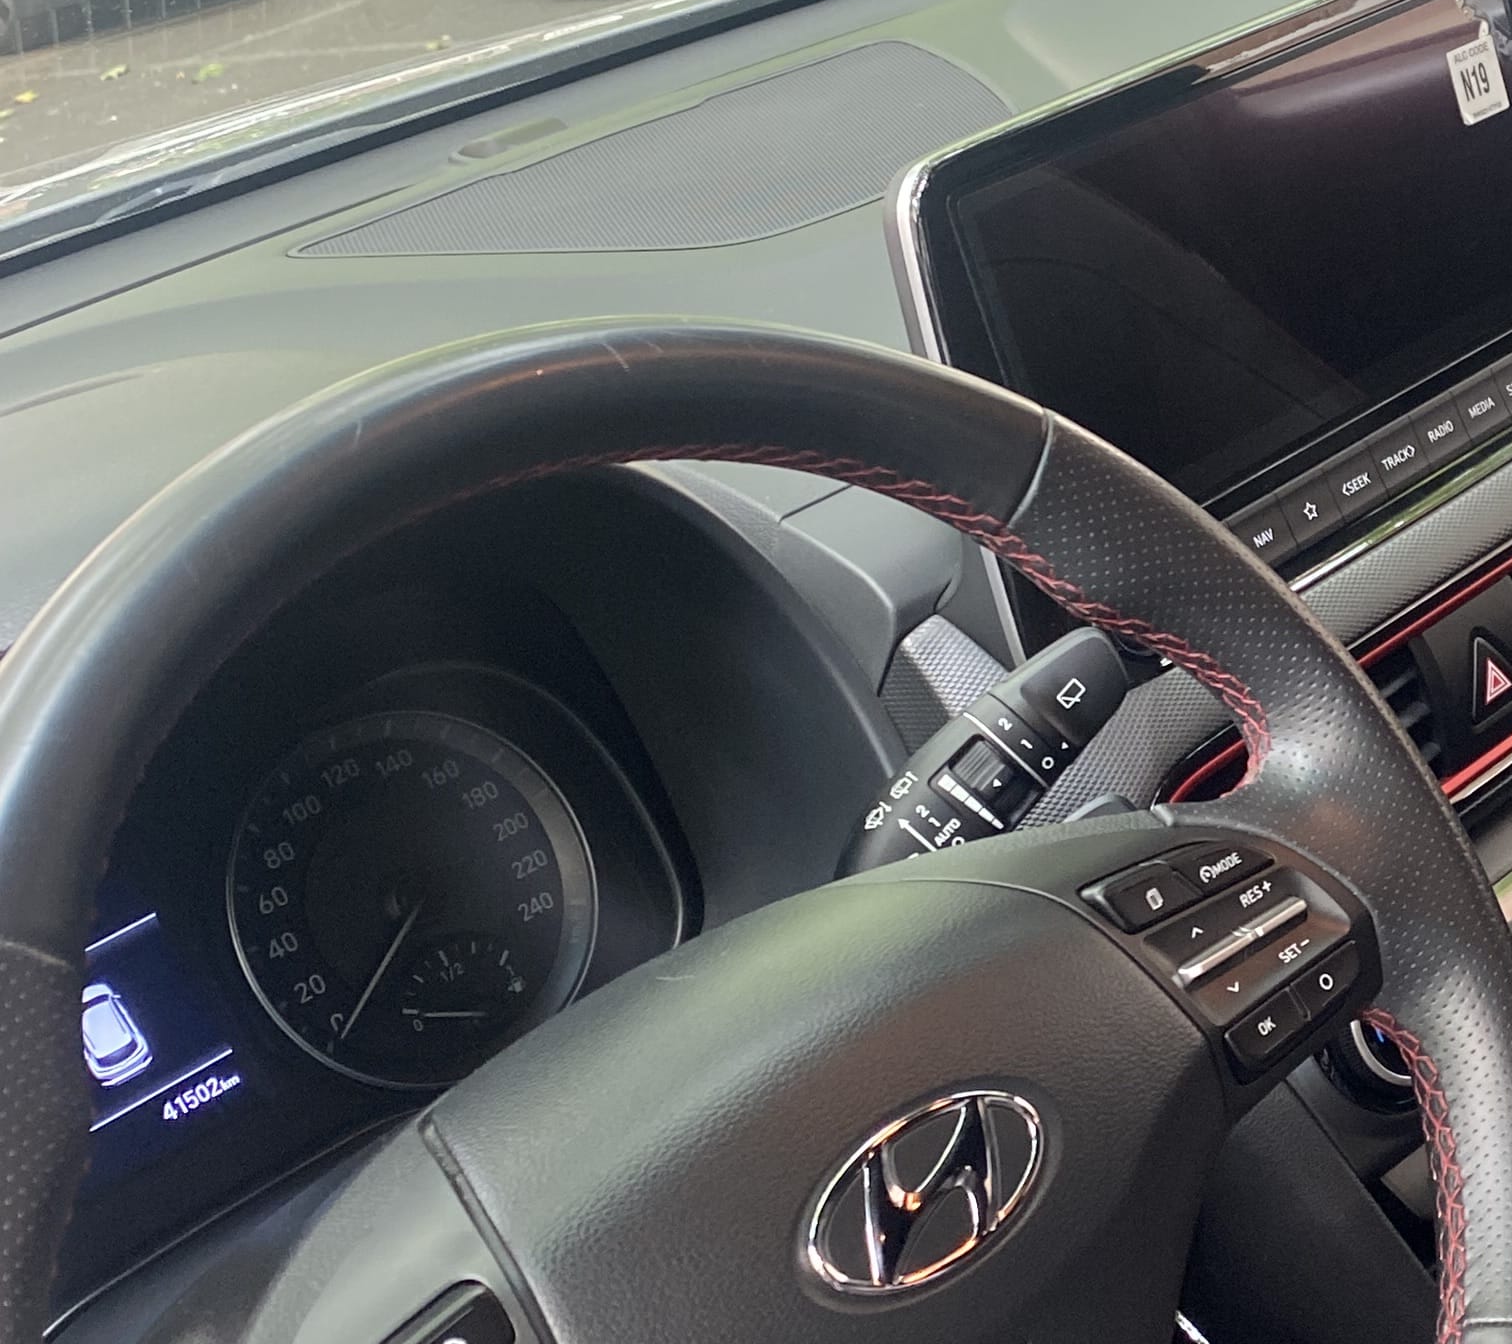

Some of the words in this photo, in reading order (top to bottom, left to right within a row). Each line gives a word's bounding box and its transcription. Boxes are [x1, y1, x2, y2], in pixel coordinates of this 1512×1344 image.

[1460, 62, 1490, 102] N19
[1468, 396, 1496, 420] MEDIA
[1427, 419, 1455, 444] RADIO
[1252, 527, 1275, 548] NAV
[319, 759, 361, 787] 120
[374, 749, 414, 777] 140
[420, 759, 461, 787] 160
[461, 780, 499, 810] 180
[281, 795, 322, 826] 100
[492, 812, 529, 842] 200
[934, 817, 962, 847] AUTO
[263, 841, 296, 869] 80
[511, 848, 549, 880] 220
[1212, 852, 1243, 875] MODE
[258, 885, 289, 915] 60
[517, 890, 554, 922] 240
[268, 931, 299, 960] 40
[293, 973, 327, 1004] 20
[1257, 1016, 1277, 1037] OK
